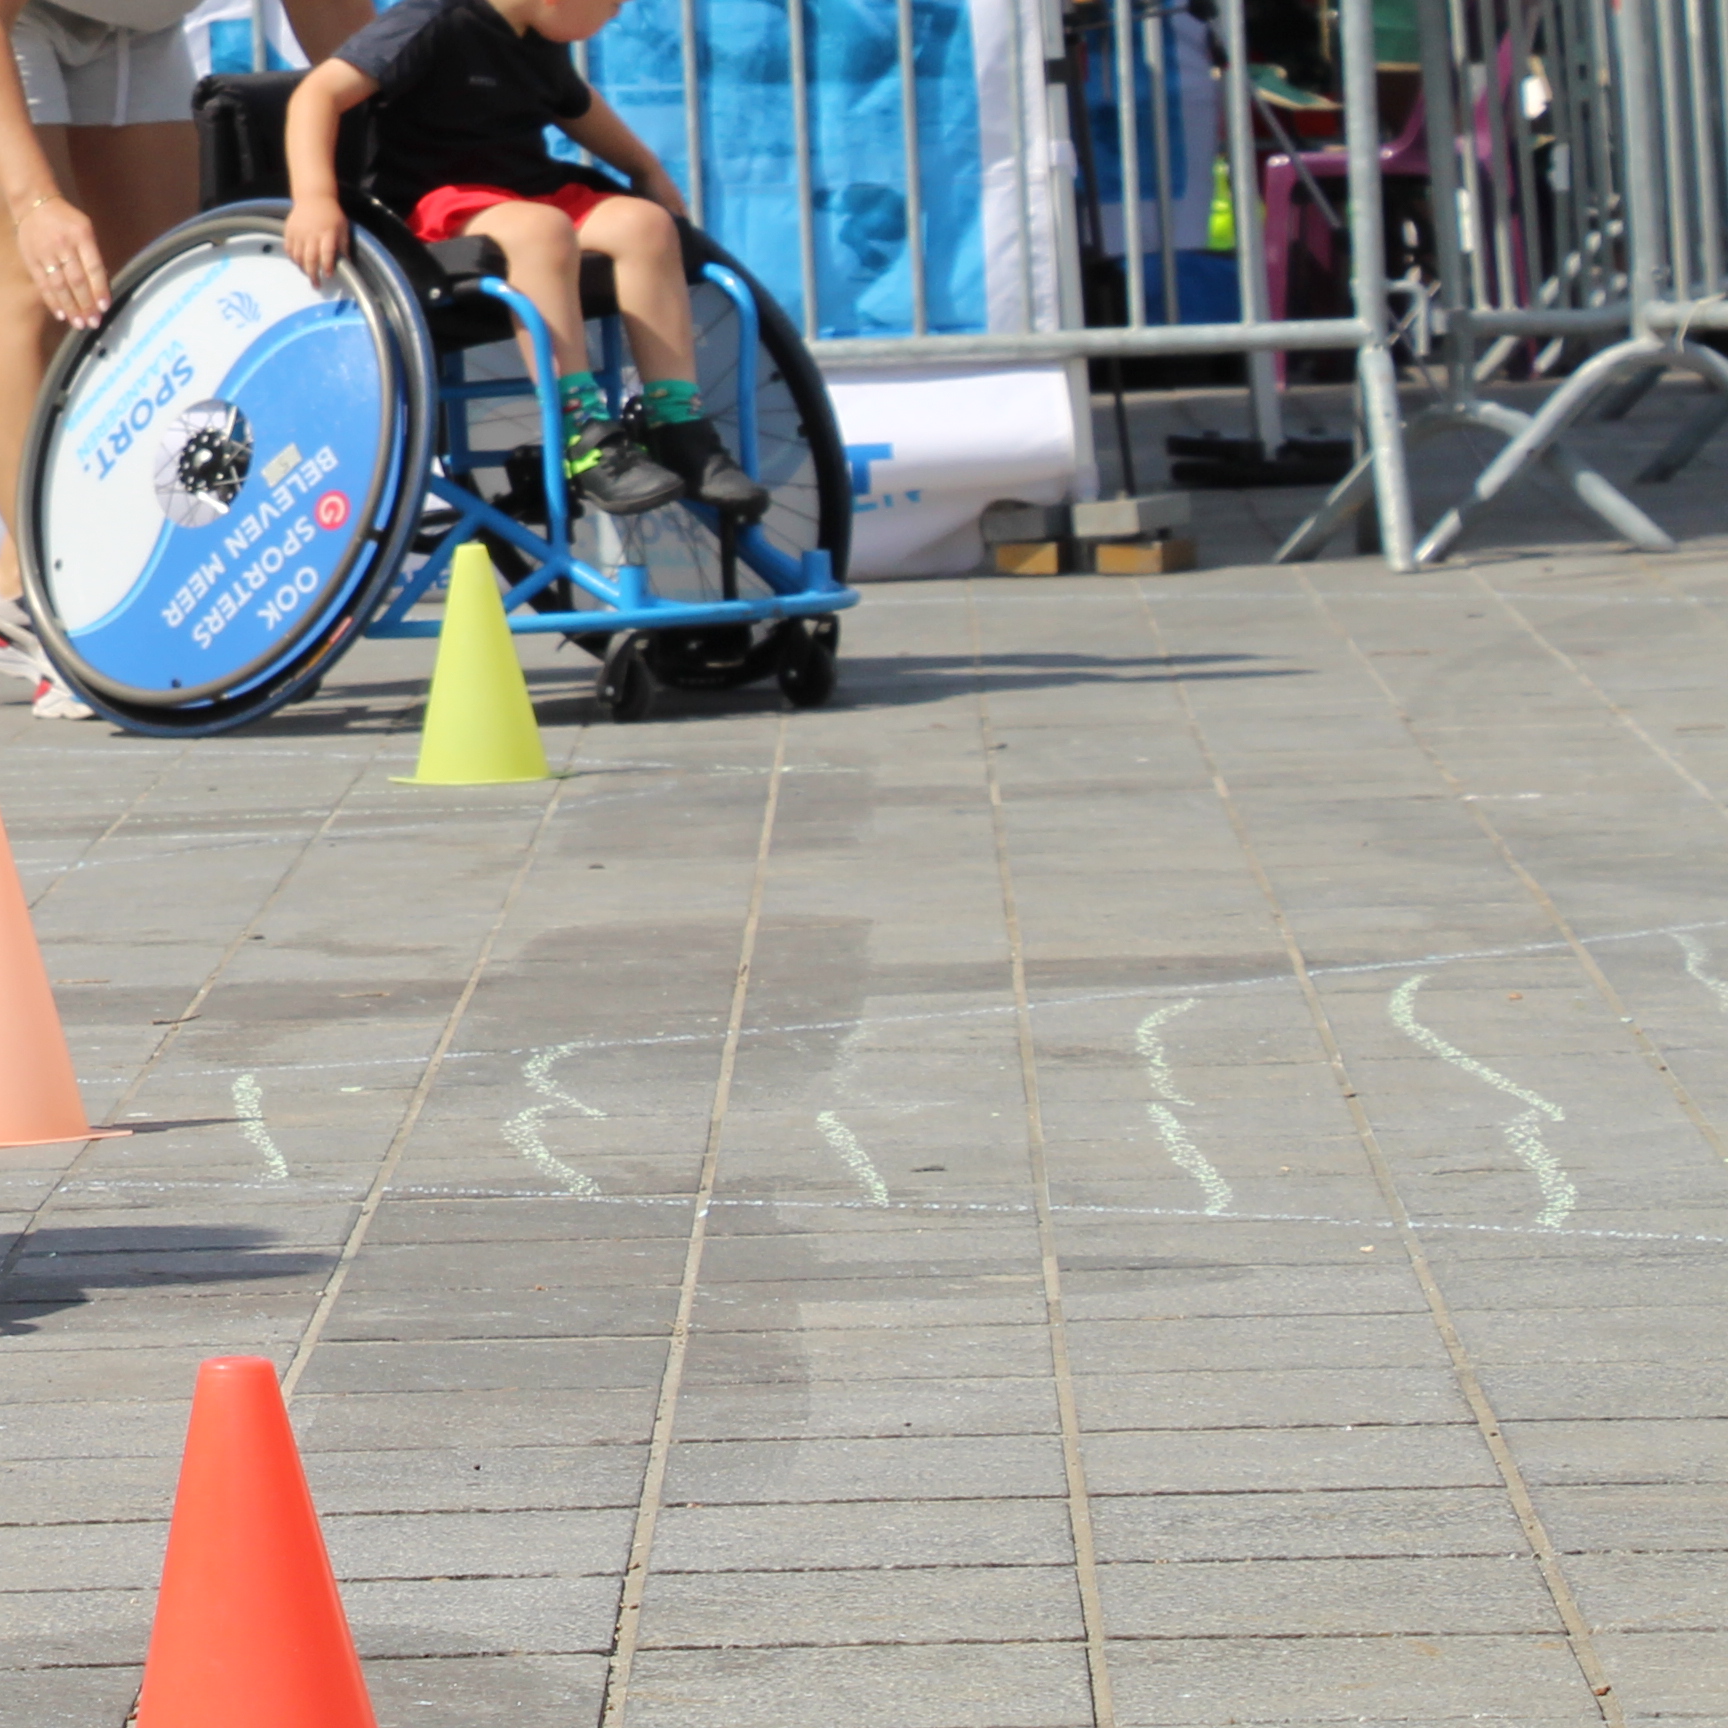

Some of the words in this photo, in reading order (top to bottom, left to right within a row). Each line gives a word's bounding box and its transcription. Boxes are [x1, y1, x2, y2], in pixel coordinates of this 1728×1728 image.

[83, 354, 195, 481] SPORT.
[223, 445, 339, 560] BELEVEN
[161, 551, 226, 629] MEER
[192, 516, 316, 650] SPORTERS
[257, 565, 319, 631] OOK
